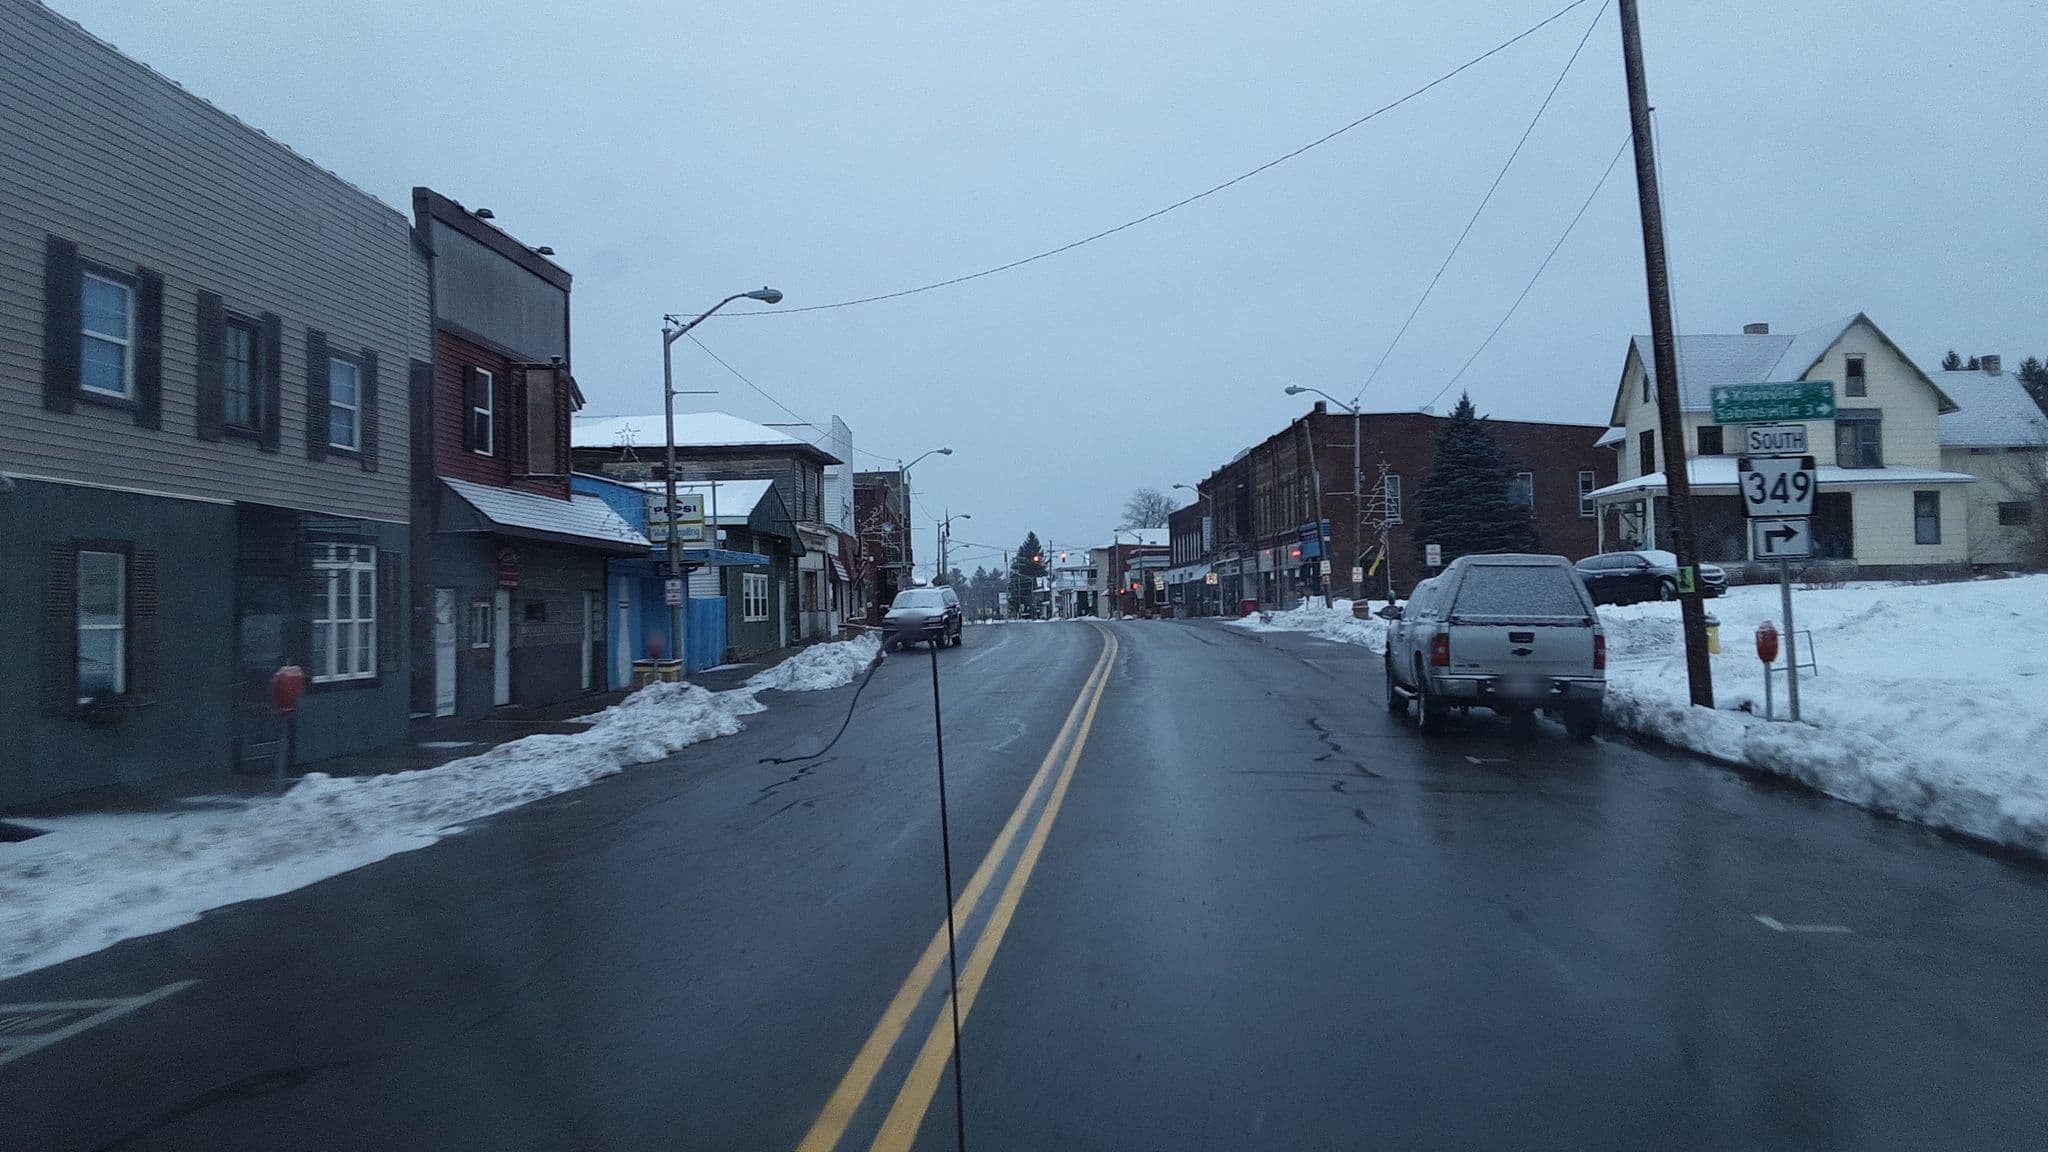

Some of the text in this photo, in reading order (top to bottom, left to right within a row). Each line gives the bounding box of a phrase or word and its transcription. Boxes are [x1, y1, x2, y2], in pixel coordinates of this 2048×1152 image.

[1805, 403, 1815, 417] 3
[1750, 430, 1803, 450] SOUTH
[1748, 472, 1810, 505] 349
